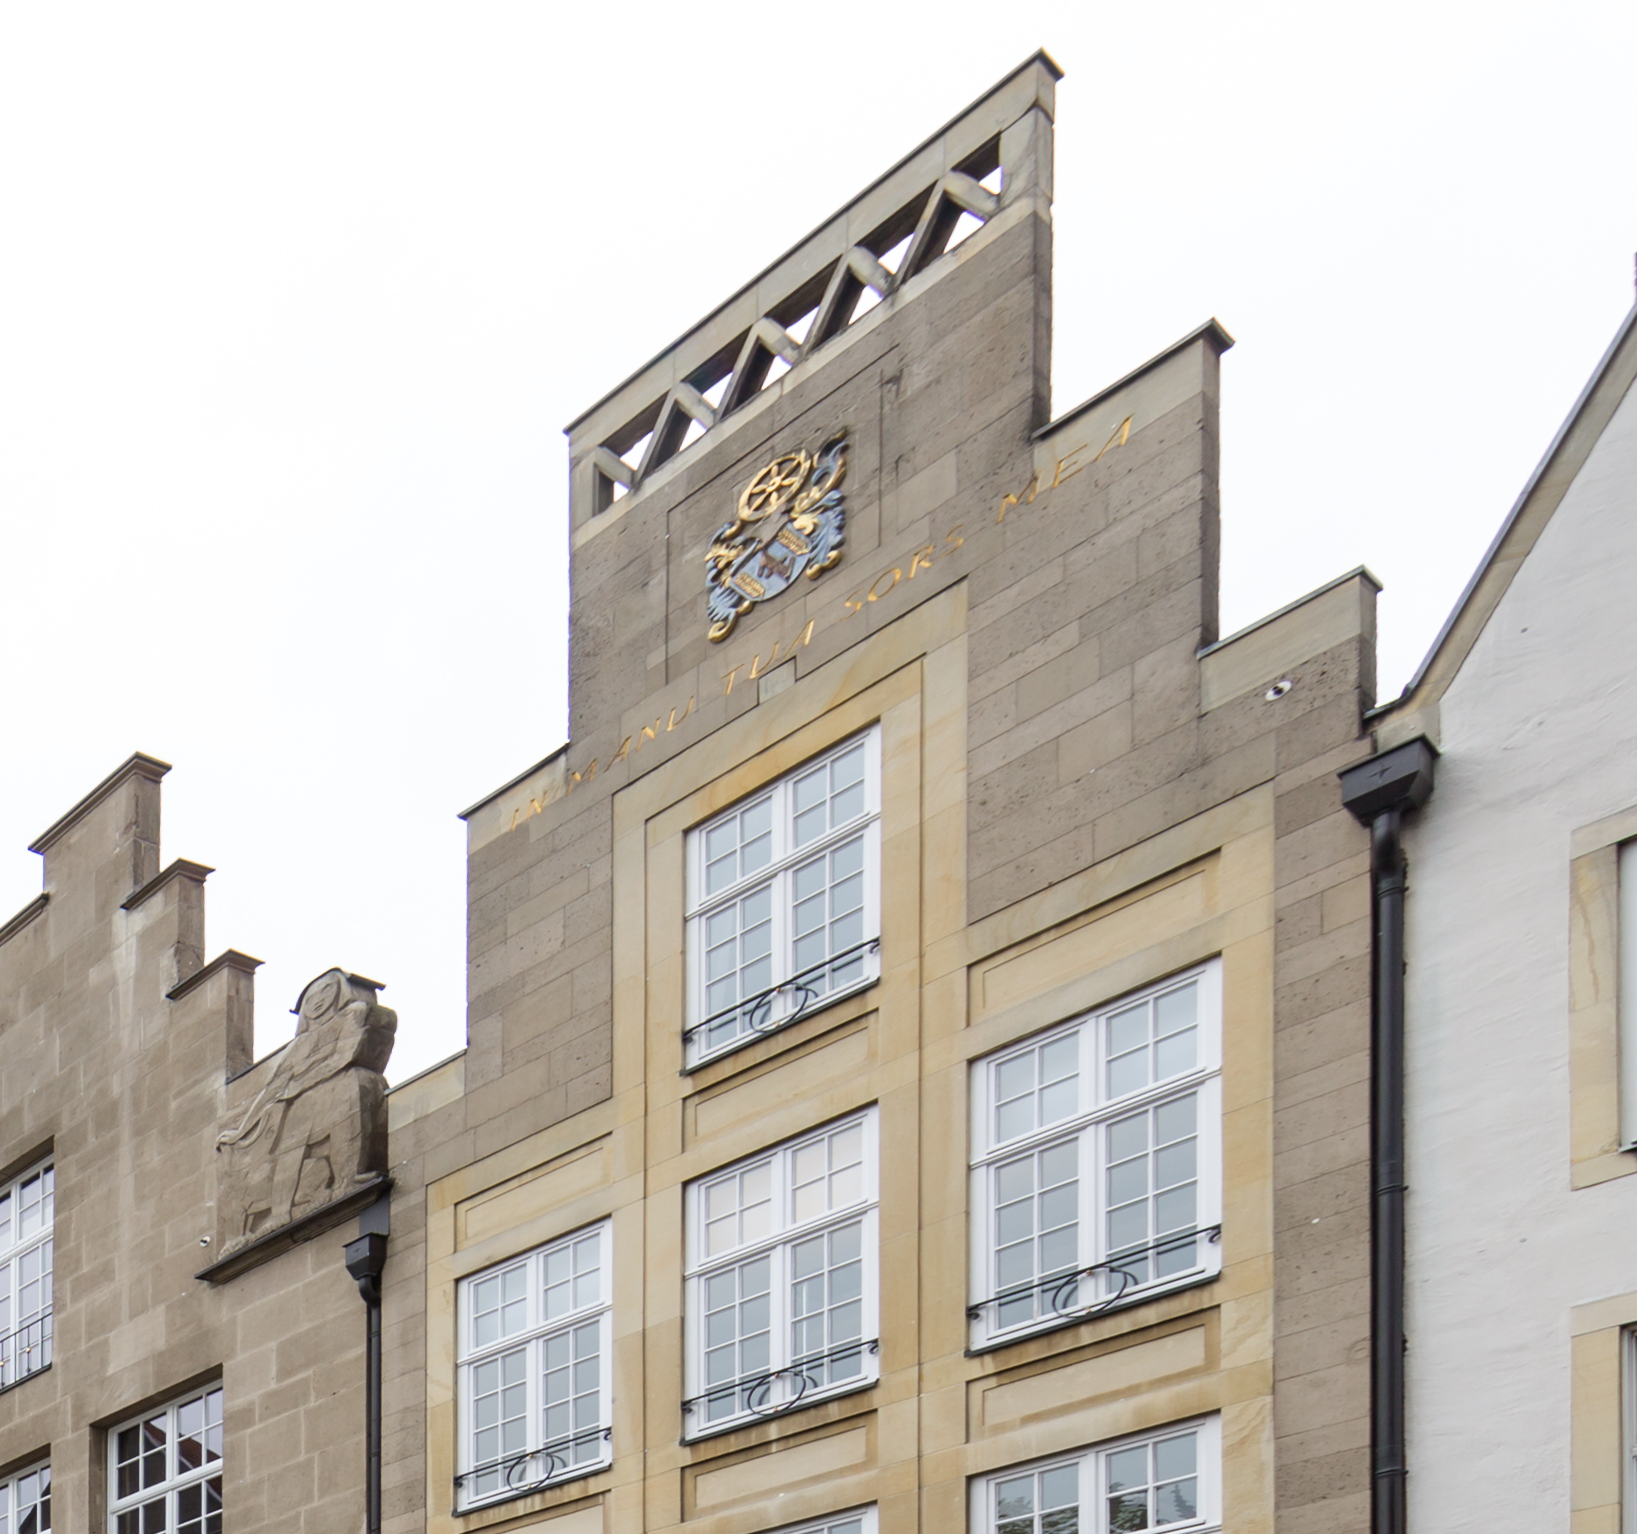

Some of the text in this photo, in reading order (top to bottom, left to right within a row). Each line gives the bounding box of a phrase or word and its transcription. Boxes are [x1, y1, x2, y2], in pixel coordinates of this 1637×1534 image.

[568, 695, 695, 794] MANU
[721, 618, 815, 697] TUA
[839, 524, 965, 622] SORS
[996, 413, 1134, 525] MEA
